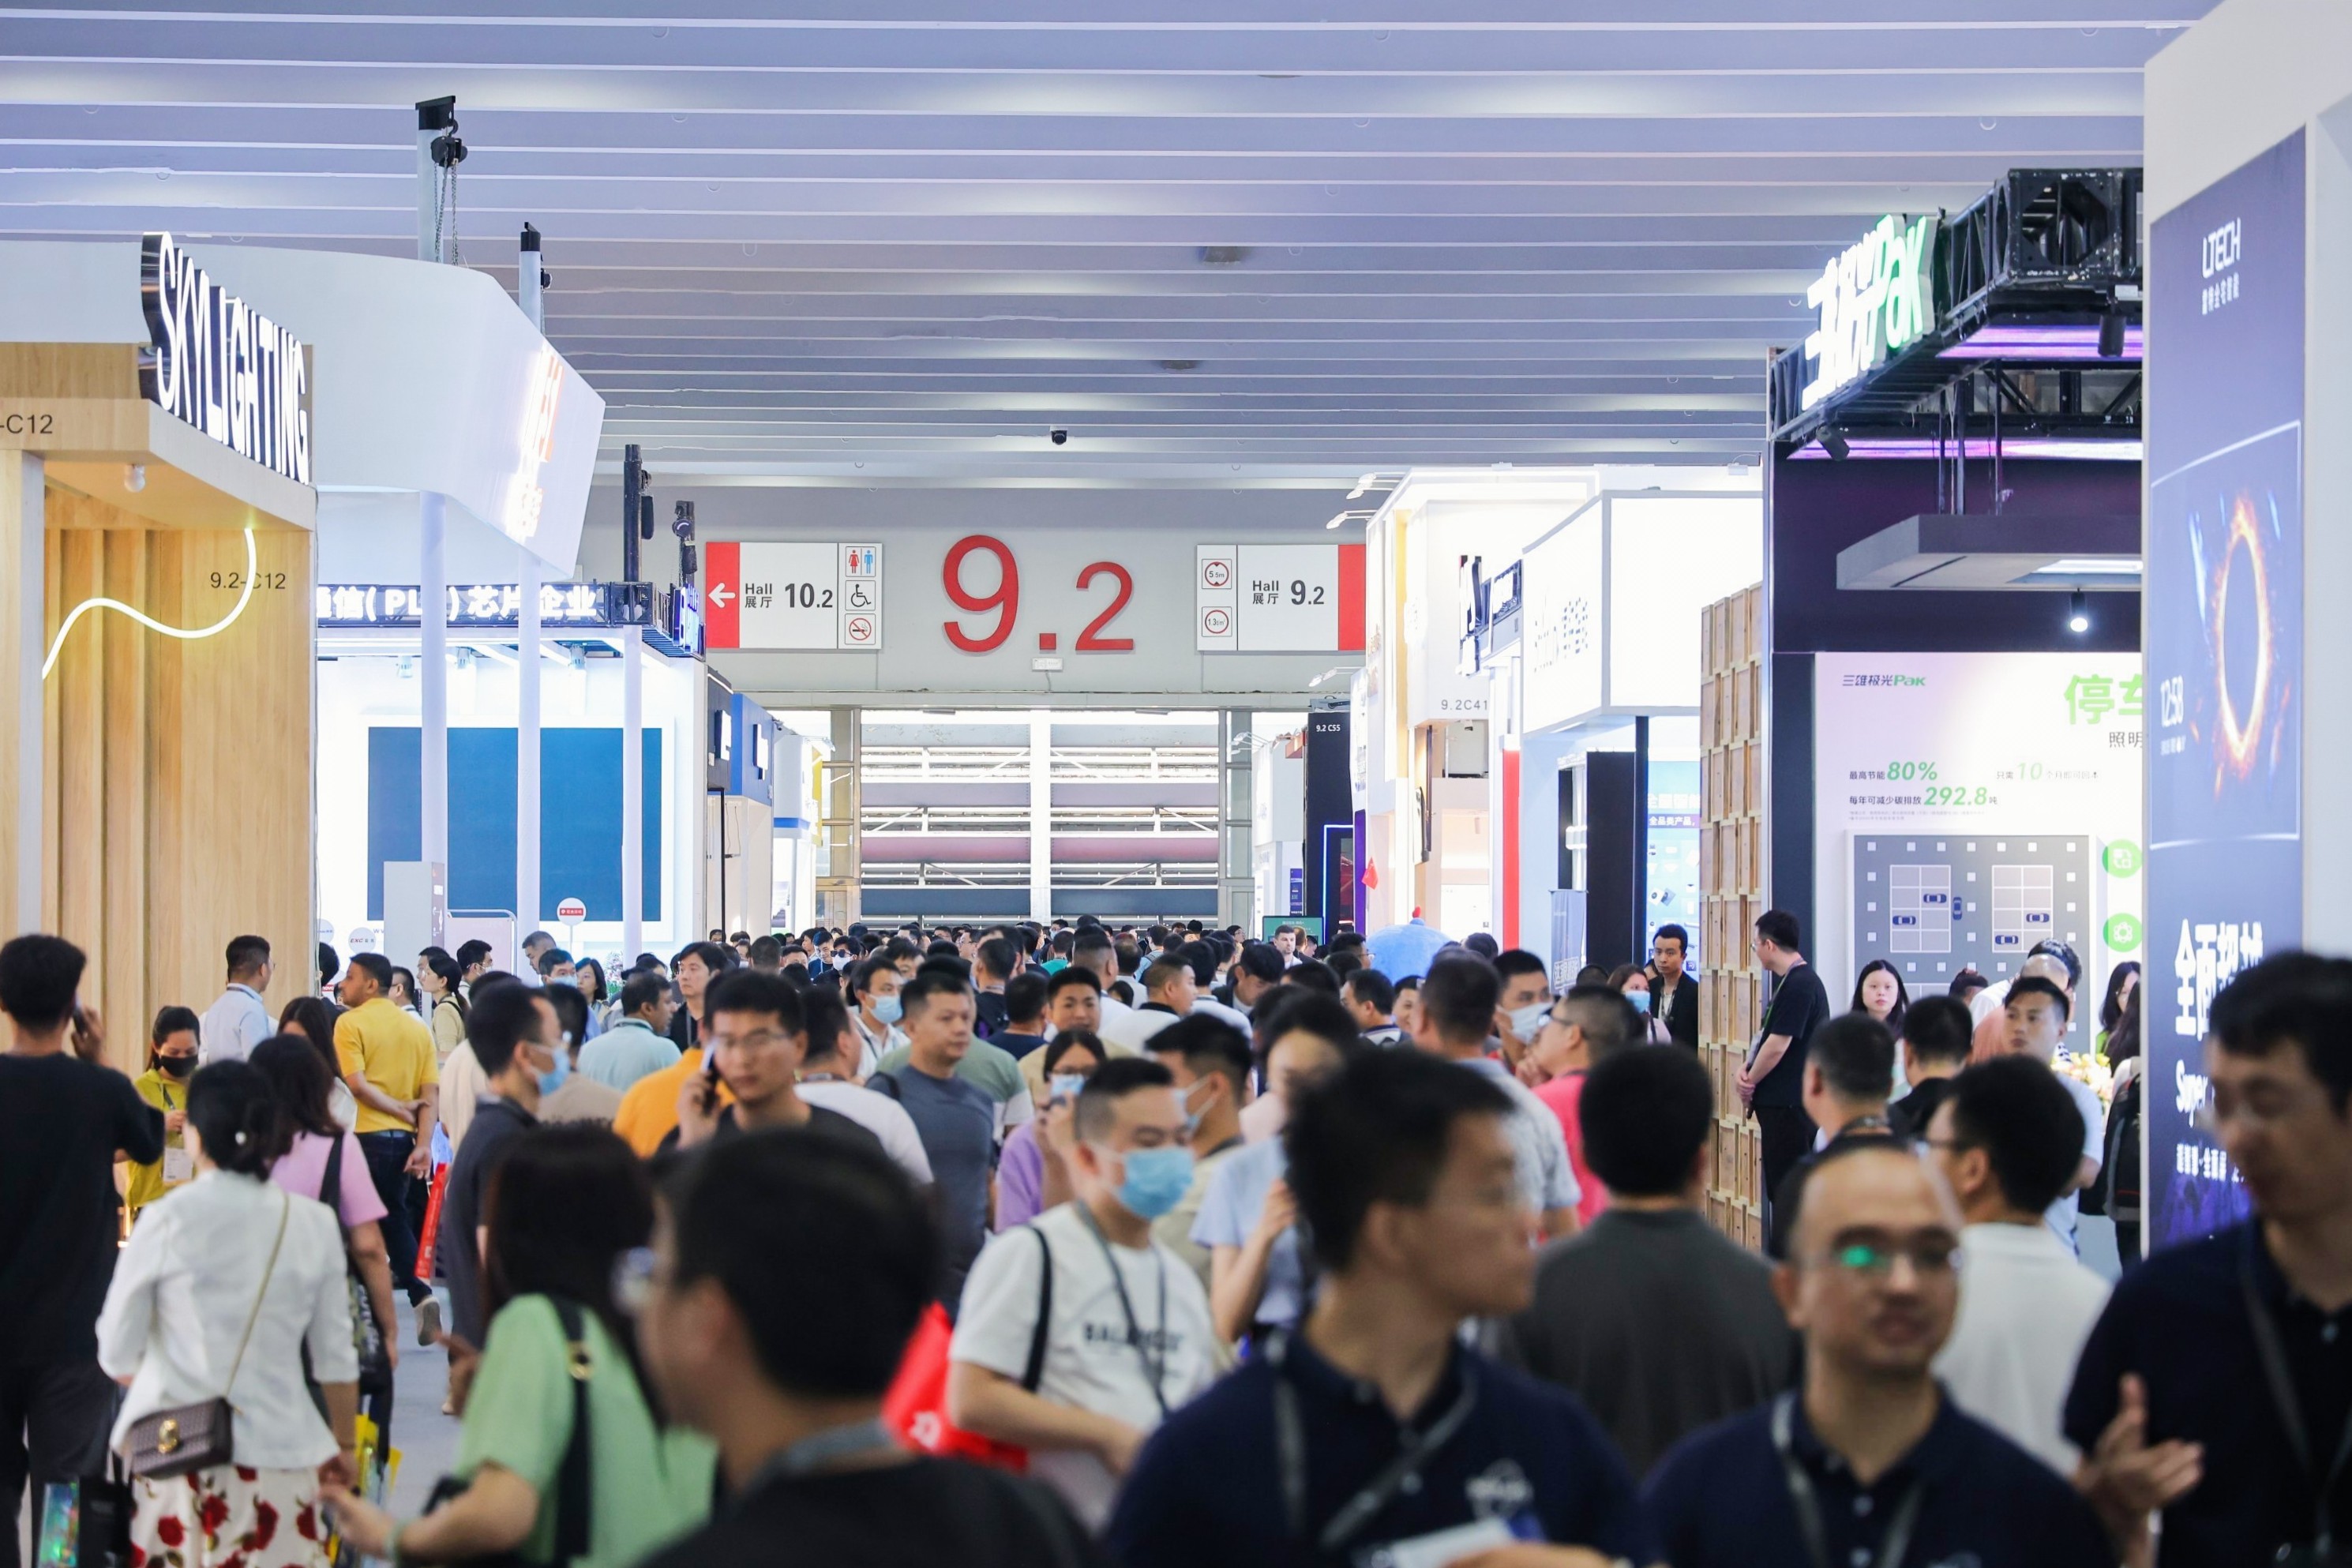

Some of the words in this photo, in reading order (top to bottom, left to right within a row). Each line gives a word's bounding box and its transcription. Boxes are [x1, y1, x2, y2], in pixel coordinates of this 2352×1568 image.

[2202, 216, 2241, 279] LTECH
[156, 231, 309, 485] SKYLIGHTING
[745, 583, 772, 595] Hall
[785, 583, 833, 608] 10.2
[745, 597, 772, 608] 展厅
[943, 535, 1134, 652] 9.2
[1252, 580, 1279, 591] Hall
[1291, 580, 1325, 605] 9.2
[1253, 593, 1279, 605] 展厅
[1887, 761, 1937, 781] 80%
[2018, 762, 2043, 780] 10
[1924, 786, 1987, 805] 292.8
